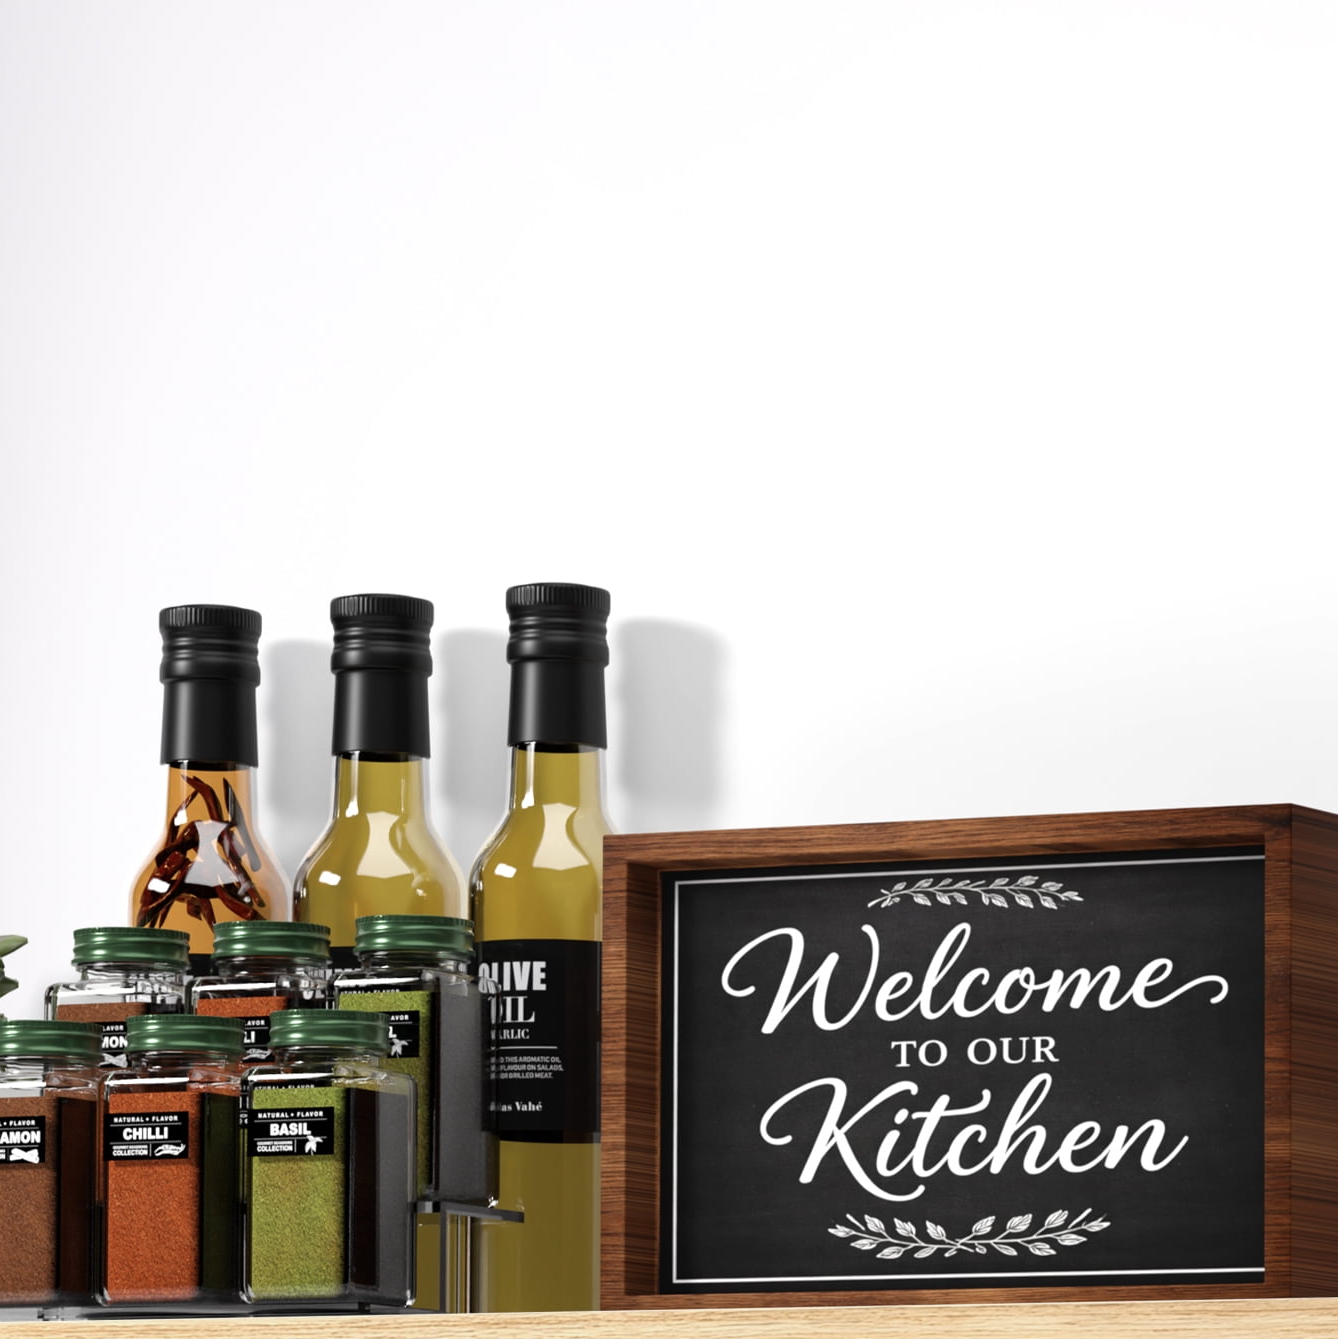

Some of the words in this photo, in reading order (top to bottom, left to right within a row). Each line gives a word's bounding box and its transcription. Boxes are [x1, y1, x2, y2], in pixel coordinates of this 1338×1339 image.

[721, 922, 1229, 1035] Welcome
[891, 1039, 949, 1067] TO
[967, 1035, 1059, 1066] OUR
[151, 1114, 179, 1122] FLAVOR
[296, 1110, 324, 1118] FLAVOR
[9, 1119, 36, 1127] FLAVOR
[269, 1122, 312, 1137] BASIL
[122, 1126, 169, 1141] CHILLI
[761, 1072, 1189, 1202] Kitchen
[112, 1149, 148, 1157] COLLECTION
